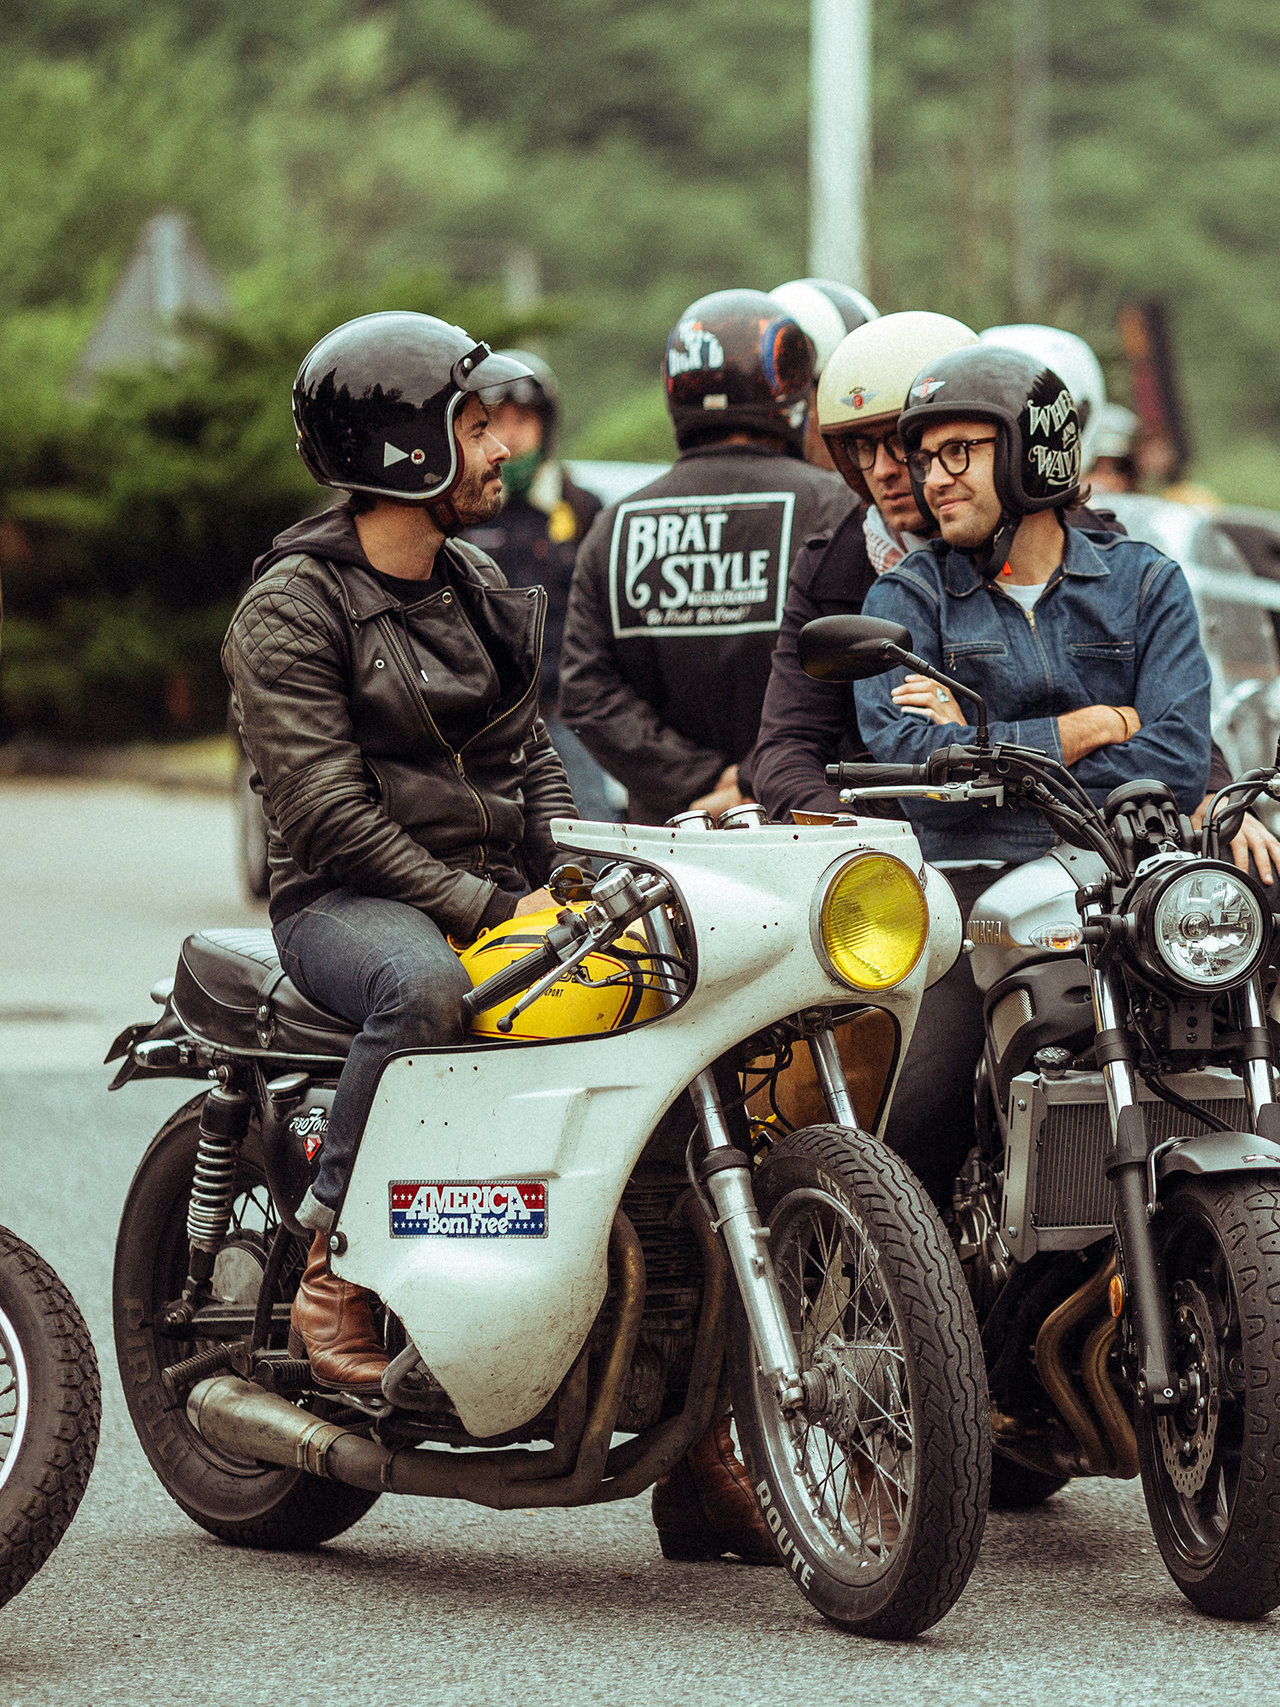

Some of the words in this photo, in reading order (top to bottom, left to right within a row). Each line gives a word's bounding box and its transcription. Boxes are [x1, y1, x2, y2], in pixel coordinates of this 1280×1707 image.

[626, 513, 729, 609] BRAT
[659, 550, 770, 609] STYLE
[966, 920, 1002, 944] AMAHA
[297, 1107, 329, 1136] Fou
[405, 1186, 531, 1220] AMERICA
[428, 1214, 469, 1233] Born
[469, 1213, 509, 1233] Free
[756, 1480, 815, 1590] ROUTE
